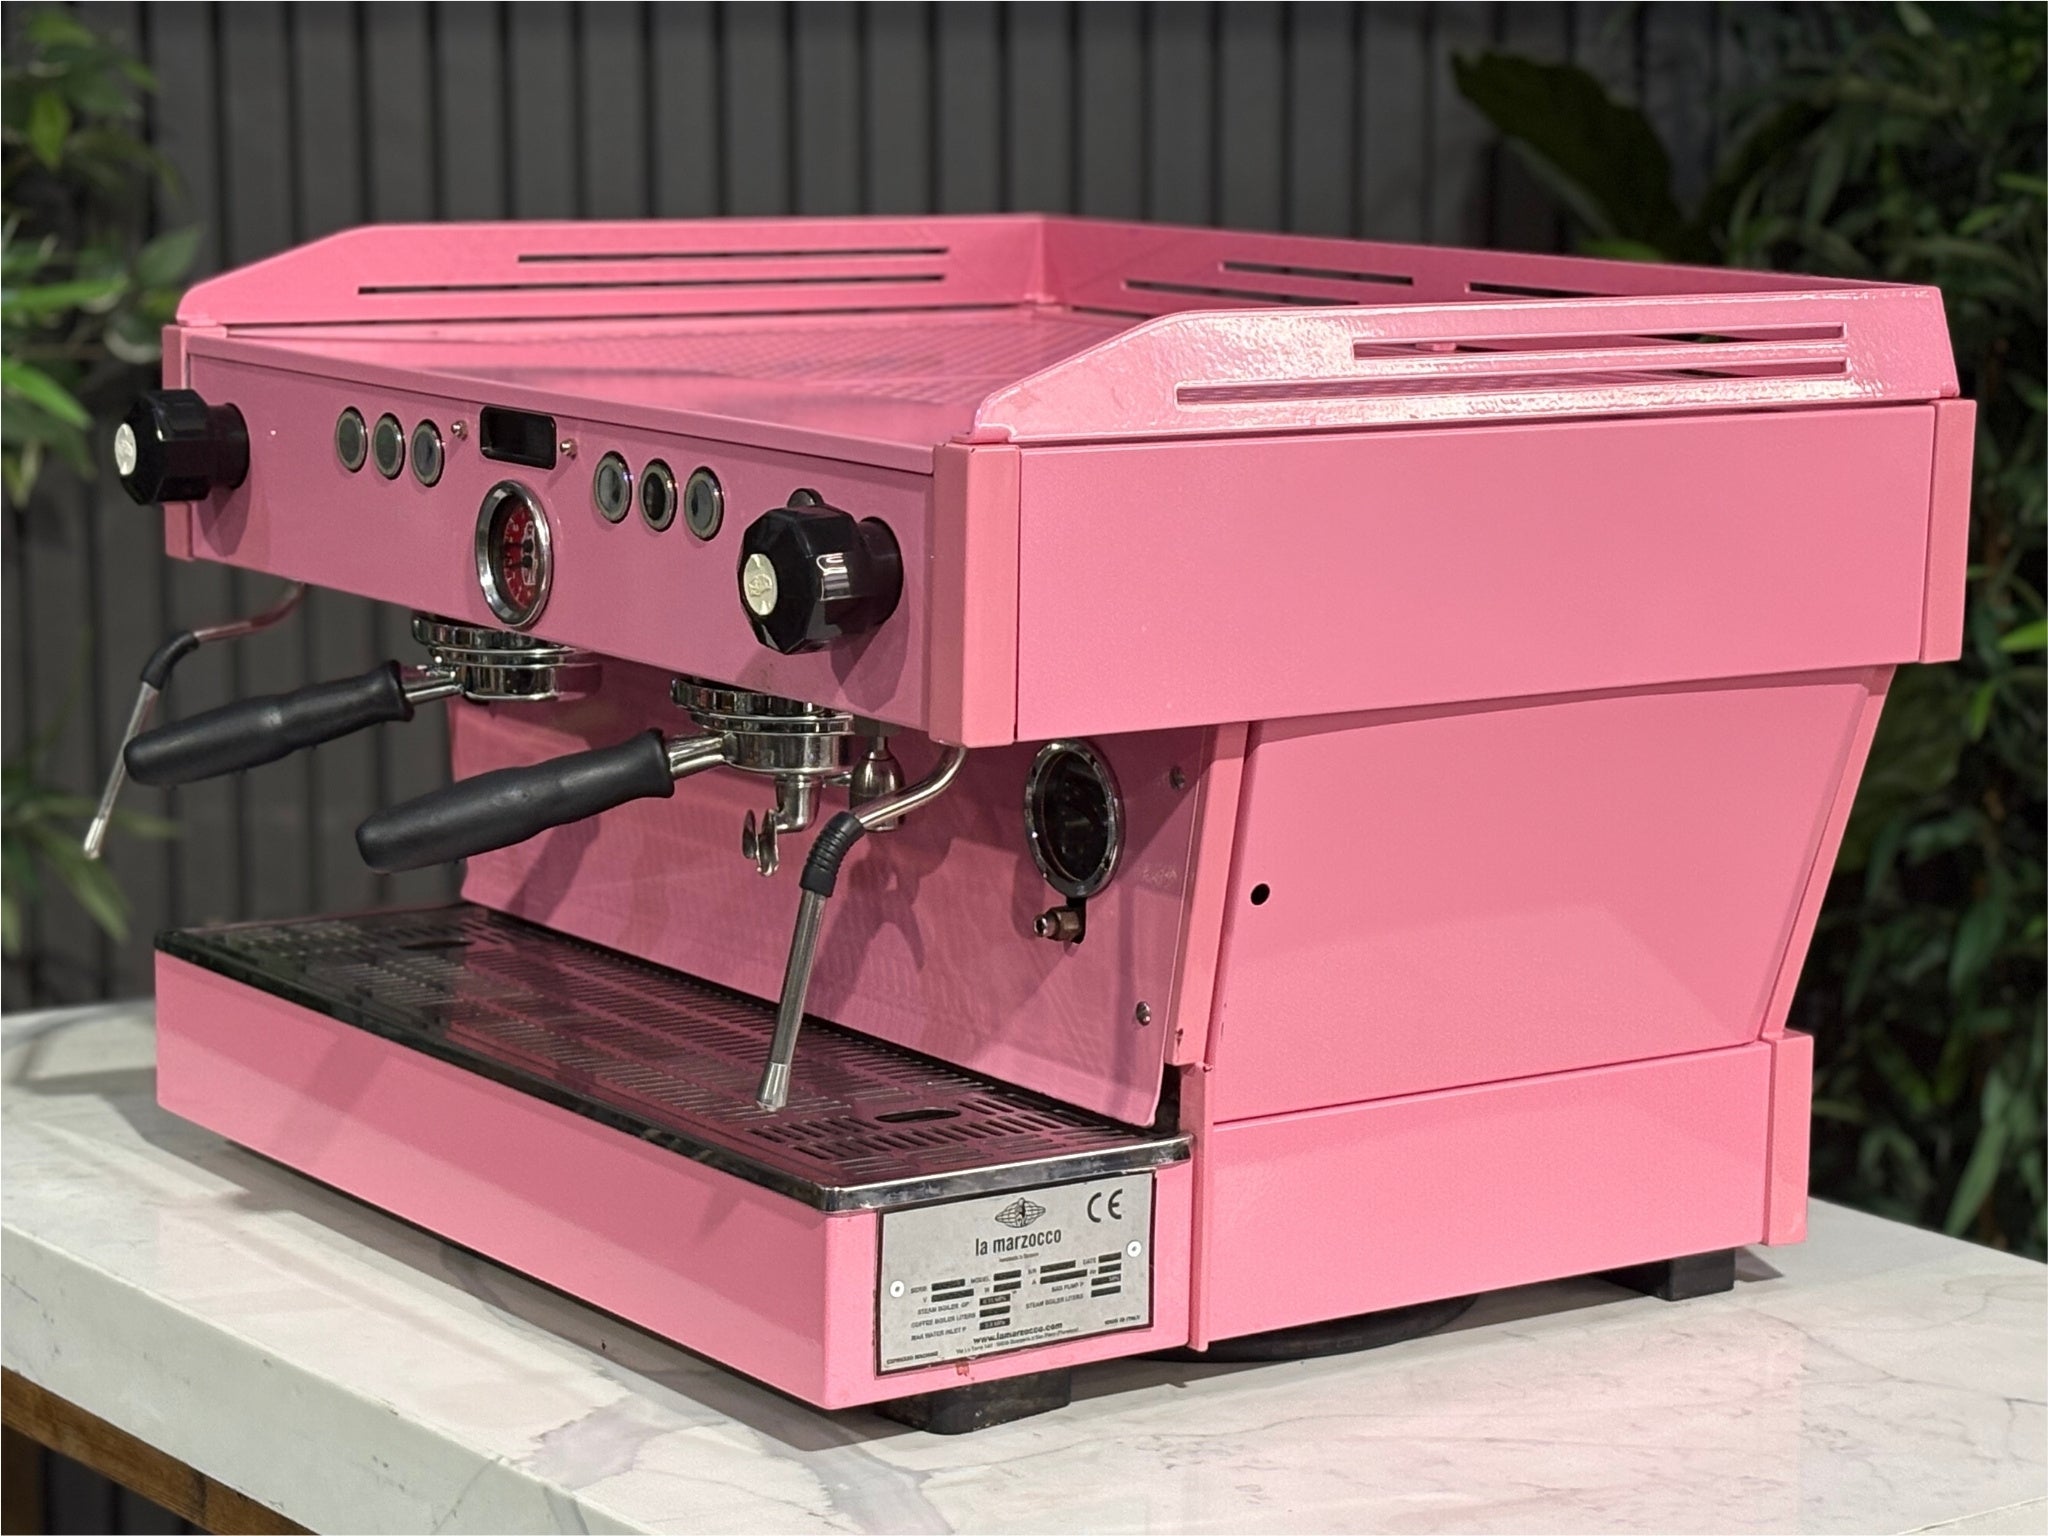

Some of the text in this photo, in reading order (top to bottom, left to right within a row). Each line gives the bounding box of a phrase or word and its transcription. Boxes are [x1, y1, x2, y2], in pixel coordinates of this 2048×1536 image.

[975, 1229, 1061, 1256] la marzocco
[917, 1305, 937, 1315] STEAM
[1025, 1300, 1044, 1309] STEAM
[910, 1318, 933, 1329] COFFEE
[973, 1322, 1063, 1345] www.lamarzocco.com
